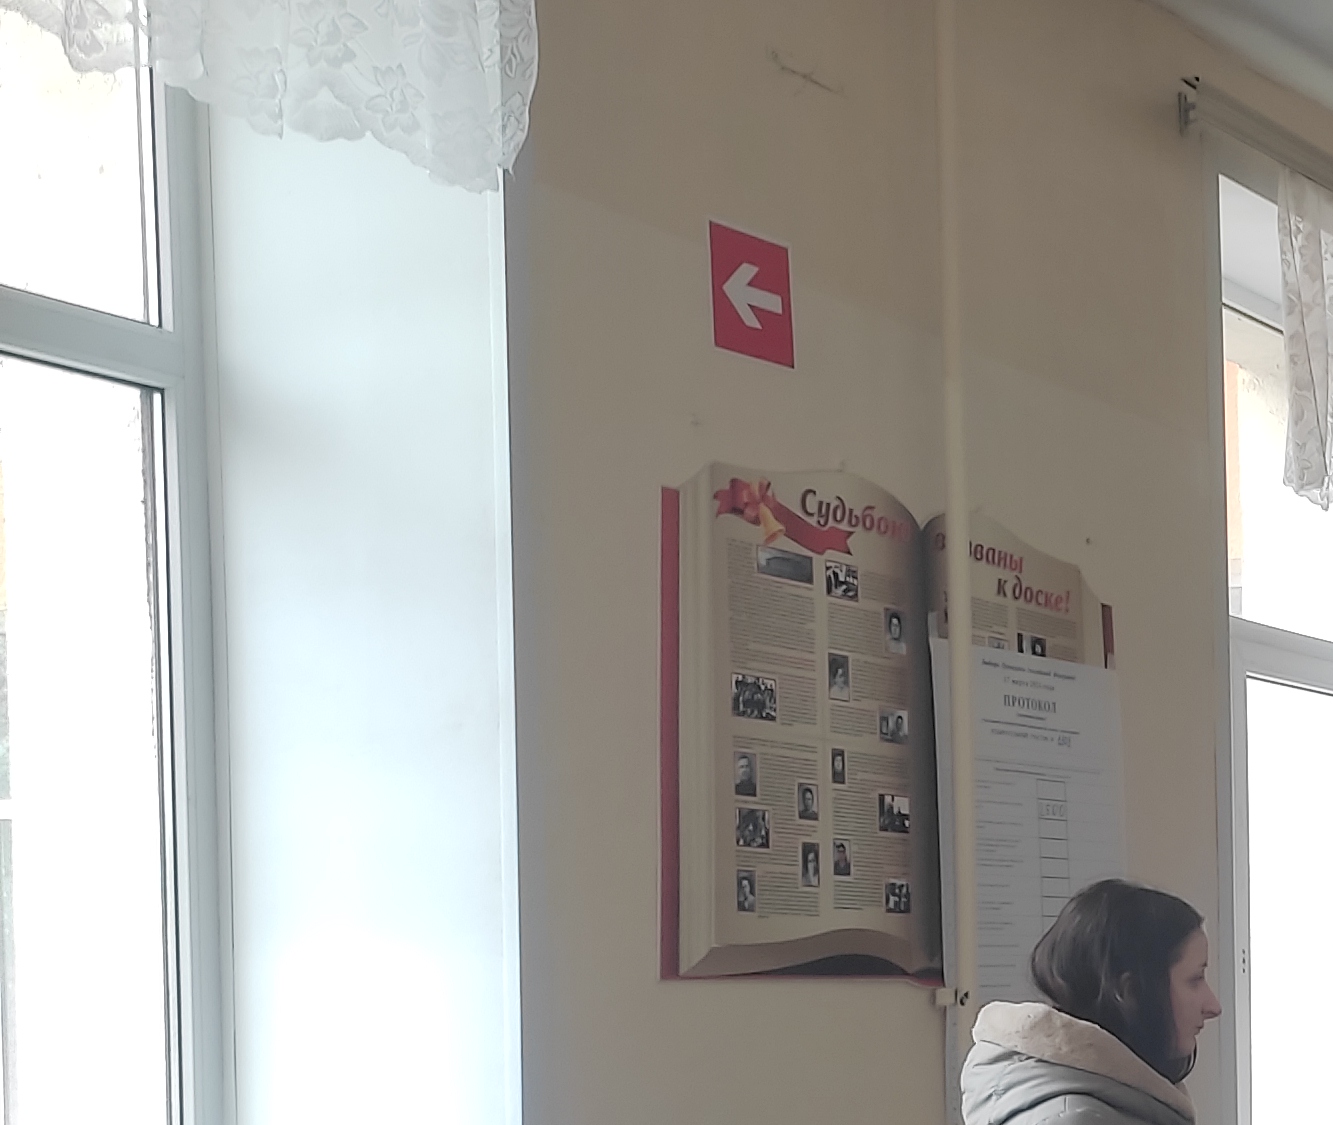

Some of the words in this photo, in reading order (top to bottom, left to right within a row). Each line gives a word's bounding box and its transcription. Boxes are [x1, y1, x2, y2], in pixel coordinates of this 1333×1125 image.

[934, 532, 1024, 573] вваны
[997, 577, 1009, 598] к
[1012, 575, 1071, 613] доске!
[1003, 694, 1057, 713] ПРОТОКОЛ
